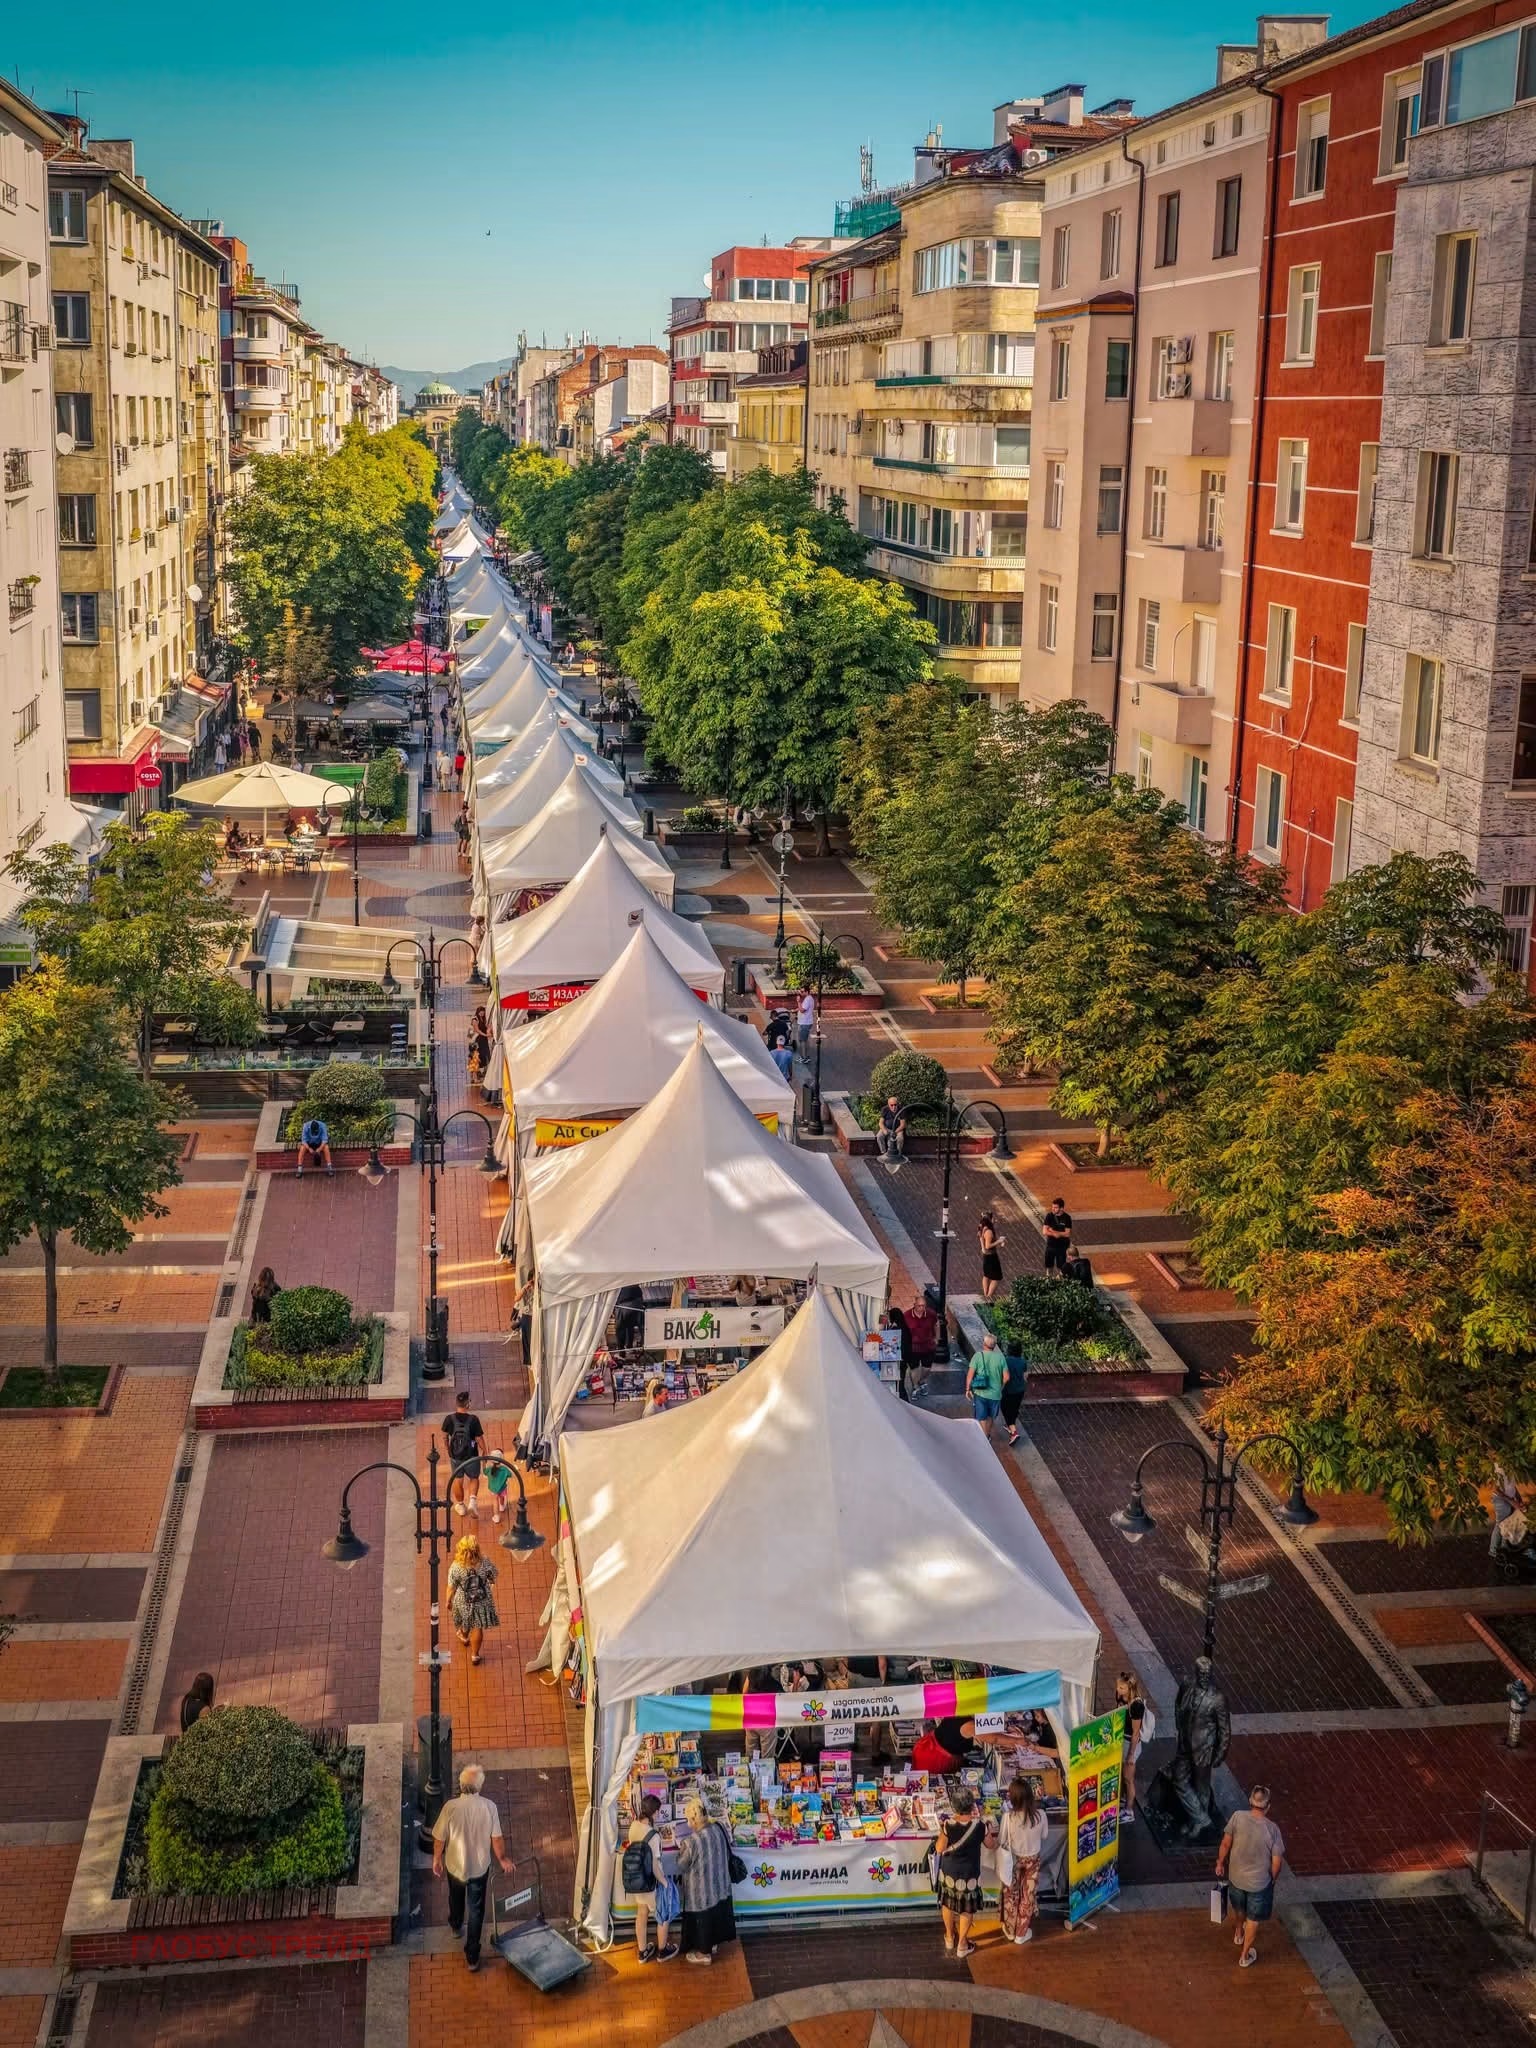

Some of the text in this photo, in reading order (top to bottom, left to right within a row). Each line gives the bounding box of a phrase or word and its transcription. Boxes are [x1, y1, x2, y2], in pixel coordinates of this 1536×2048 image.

[833, 1695, 894, 1706] издателство
[831, 1704, 900, 1720] МИРАНДА
[976, 1716, 1004, 1728] КАСА
[780, 1866, 849, 1881] МИРАНДА
